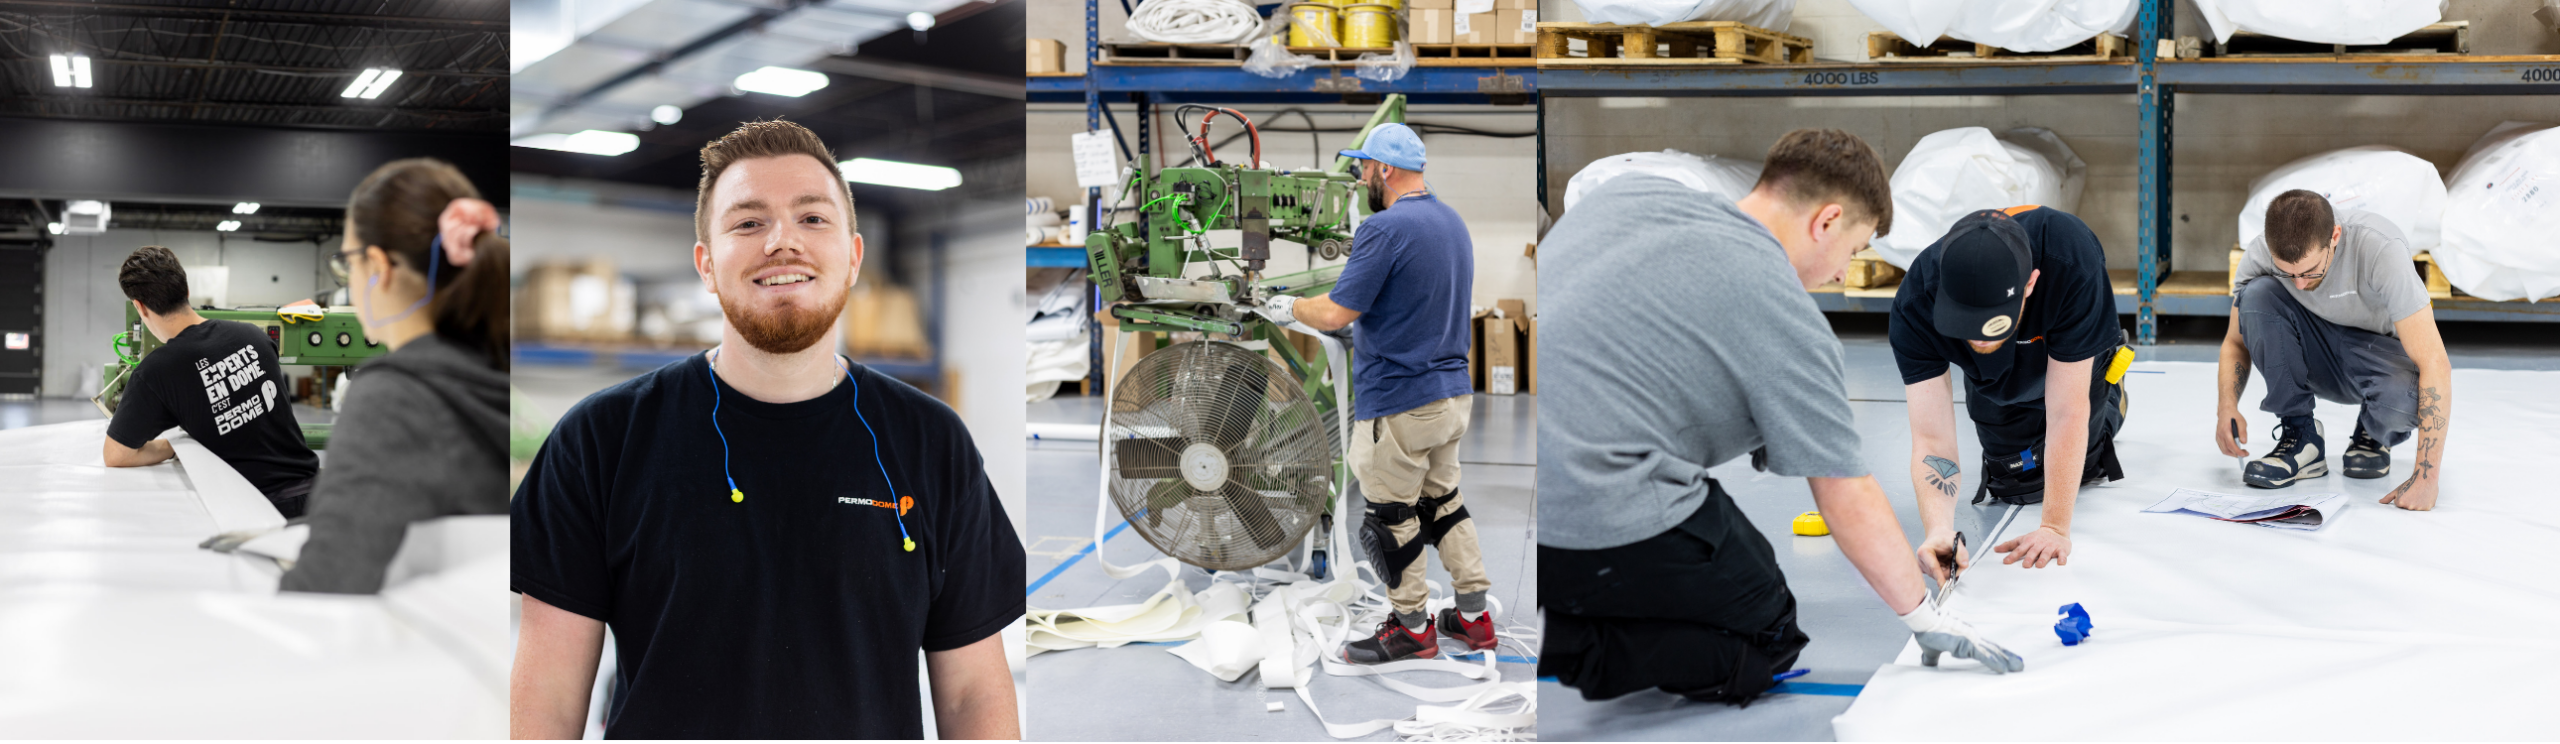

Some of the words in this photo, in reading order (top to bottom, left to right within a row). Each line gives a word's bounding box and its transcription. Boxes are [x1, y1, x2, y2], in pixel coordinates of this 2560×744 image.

[1804, 72, 1847, 85] 4000
[1851, 72, 1879, 84] LBS
[2521, 68, 2560, 82] 4000
[195, 357, 209, 371] LES
[199, 344, 259, 388] EXPERTS
[205, 380, 230, 404] EN
[211, 397, 231, 414] C'EST
[214, 394, 261, 425] PERMO
[217, 402, 264, 436] DOME
